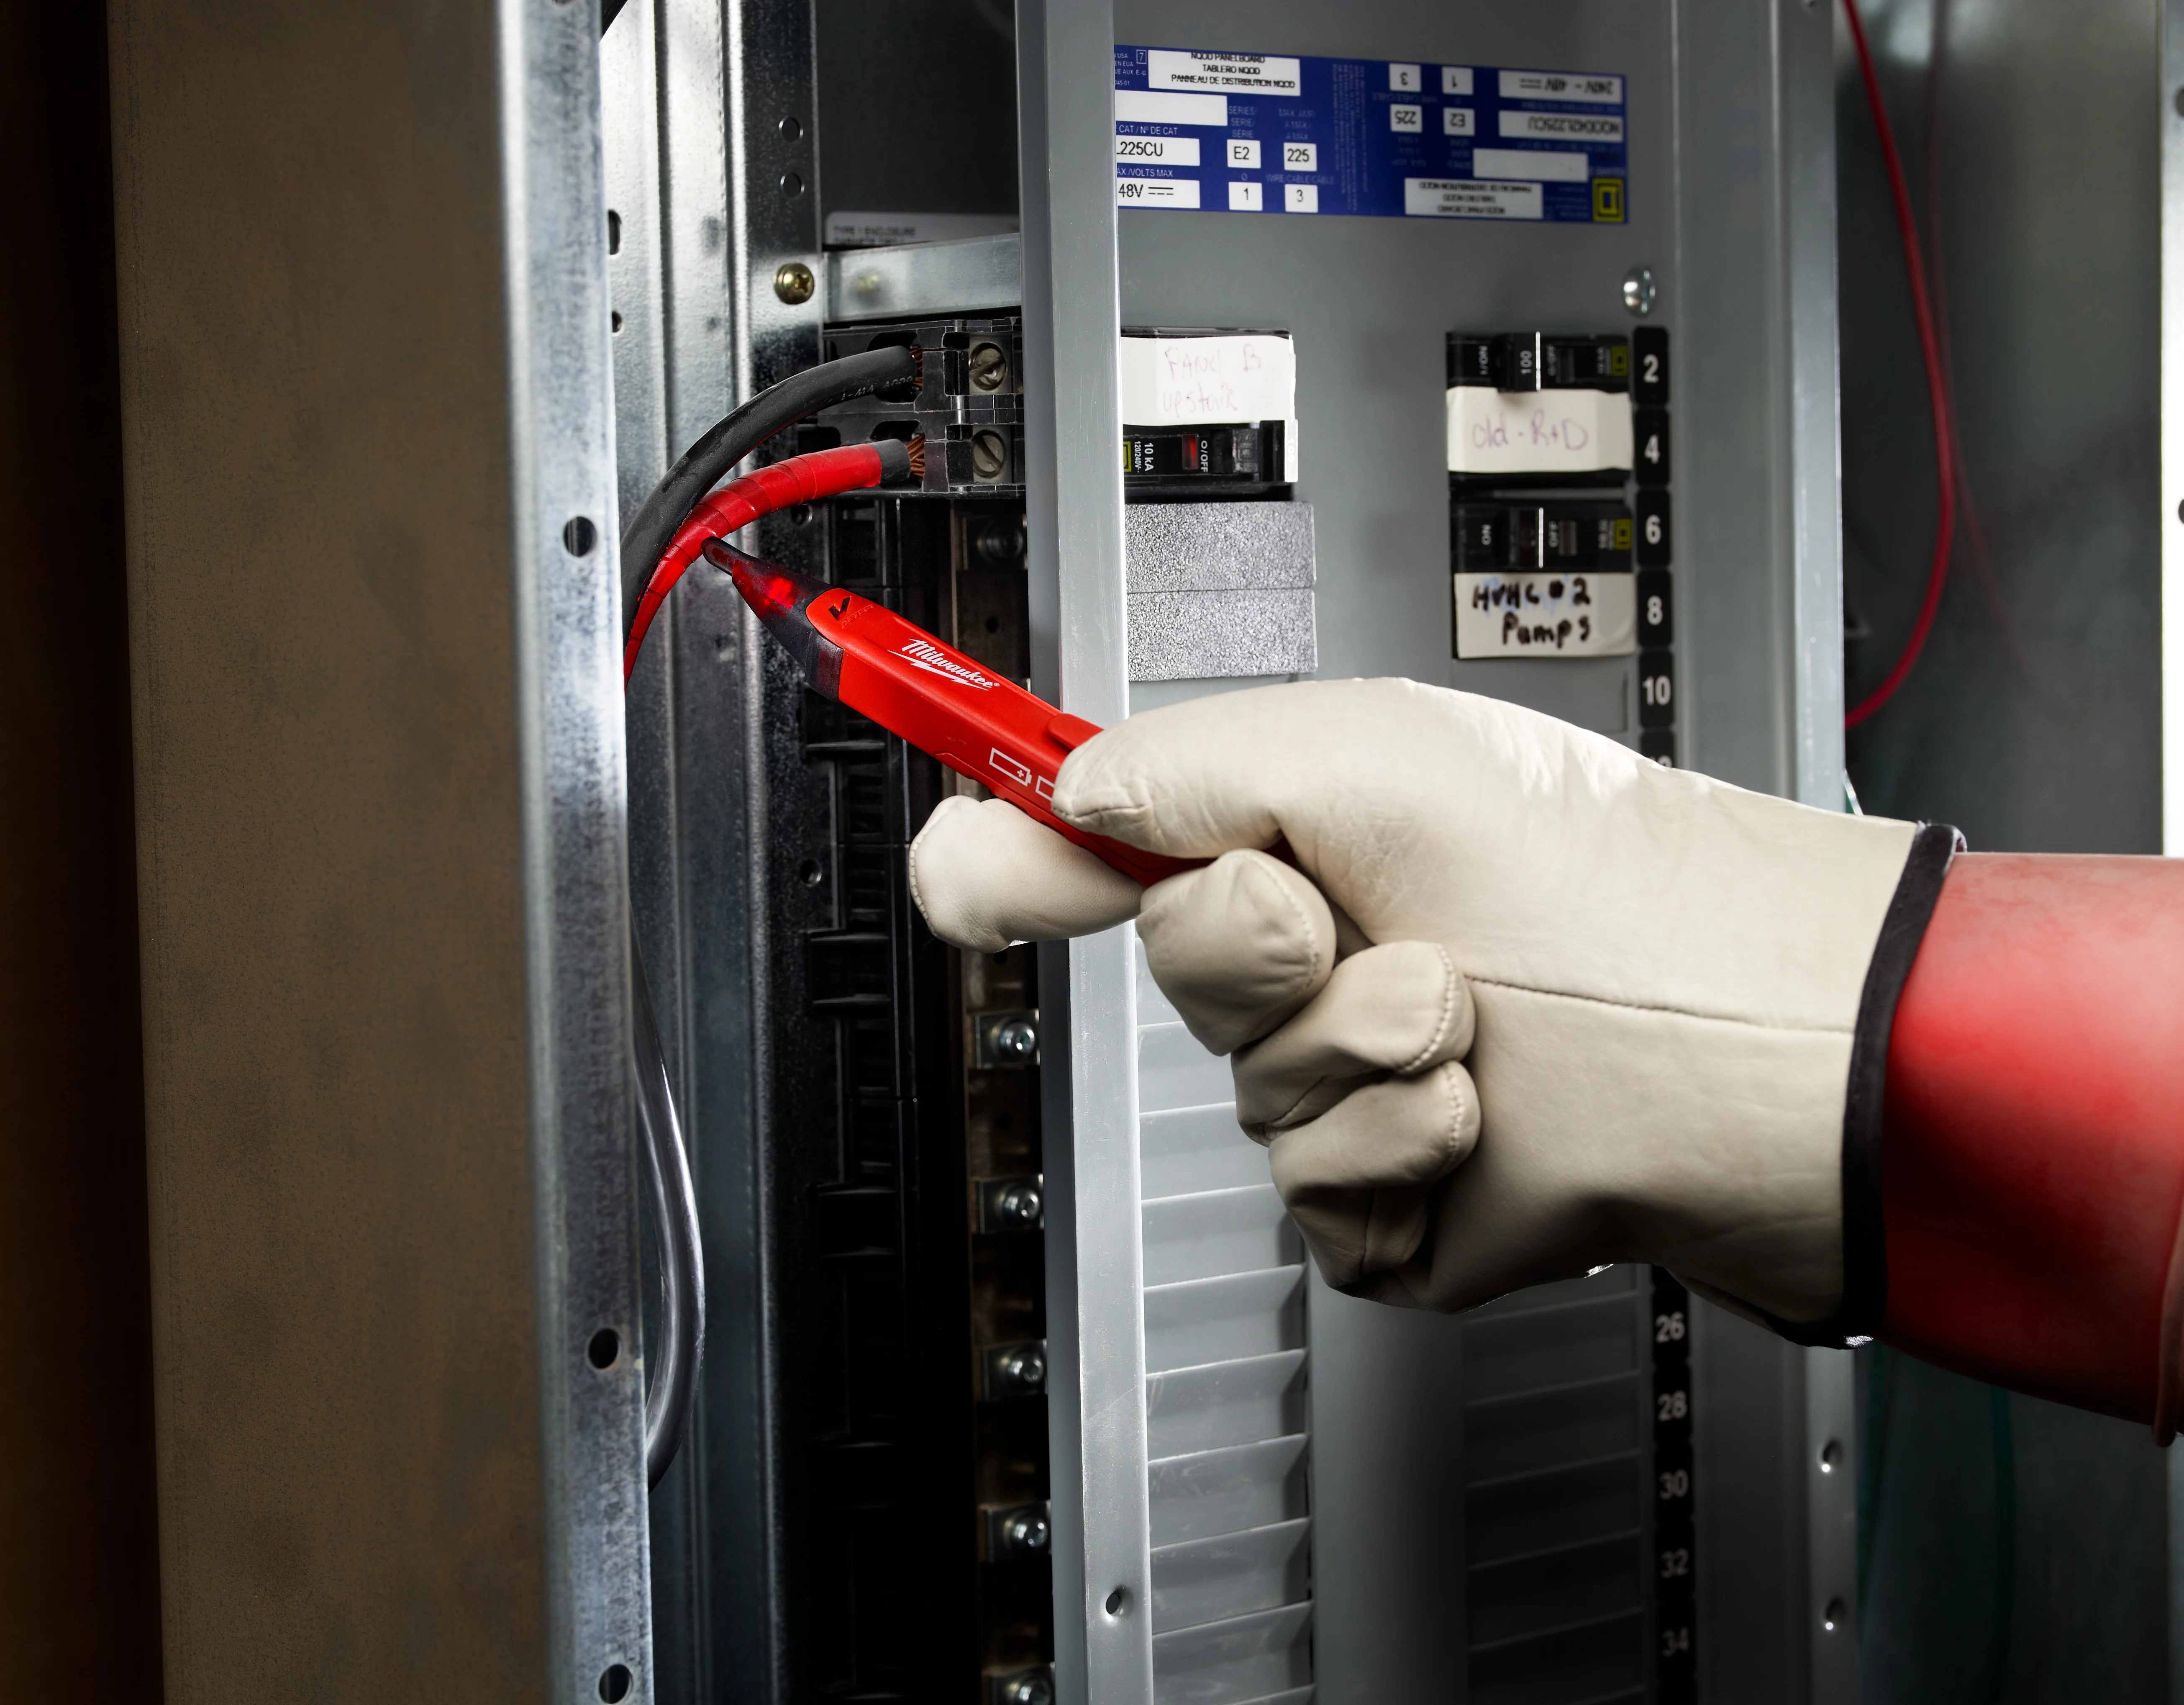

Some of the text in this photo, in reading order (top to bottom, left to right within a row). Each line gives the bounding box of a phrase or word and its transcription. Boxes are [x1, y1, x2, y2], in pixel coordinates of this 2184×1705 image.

[1139, 52, 1144, 62] 7
[1171, 74, 1208, 84] PANNEAU
[1209, 76, 1220, 85] DE
[1221, 77, 1272, 87] DISTRIBUTION
[1202, 64, 1236, 74] TABLERO
[1401, 72, 1408, 85] 3
[1452, 75, 1457, 88] 1
[1395, 110, 1417, 125] 225
[1450, 113, 1466, 127] E2
[1150, 126, 1161, 135] DE
[1233, 146, 1250, 160] E2
[1287, 148, 1310, 163] 225
[1118, 183, 1144, 199] 48V
[1243, 187, 1249, 202] 1
[1296, 188, 1304, 203] 3
[1242, 342, 1263, 372] B
[1520, 350, 1533, 375] 100
[1642, 354, 1659, 383] 2
[1144, 442, 1155, 472] 10 kA
[1644, 434, 1661, 465] 4
[1481, 524, 1492, 546] ON
[1645, 514, 1662, 544] 6
[1647, 596, 1664, 626] 8
[901, 638, 994, 689] Milwaukee
[1642, 675, 1671, 706] 10
[1655, 1311, 1686, 1343] 26
[1657, 1389, 1688, 1422] 28
[1659, 1469, 1689, 1500] 30
[1661, 1547, 1690, 1579] 32
[1662, 1625, 1690, 1657] 34
